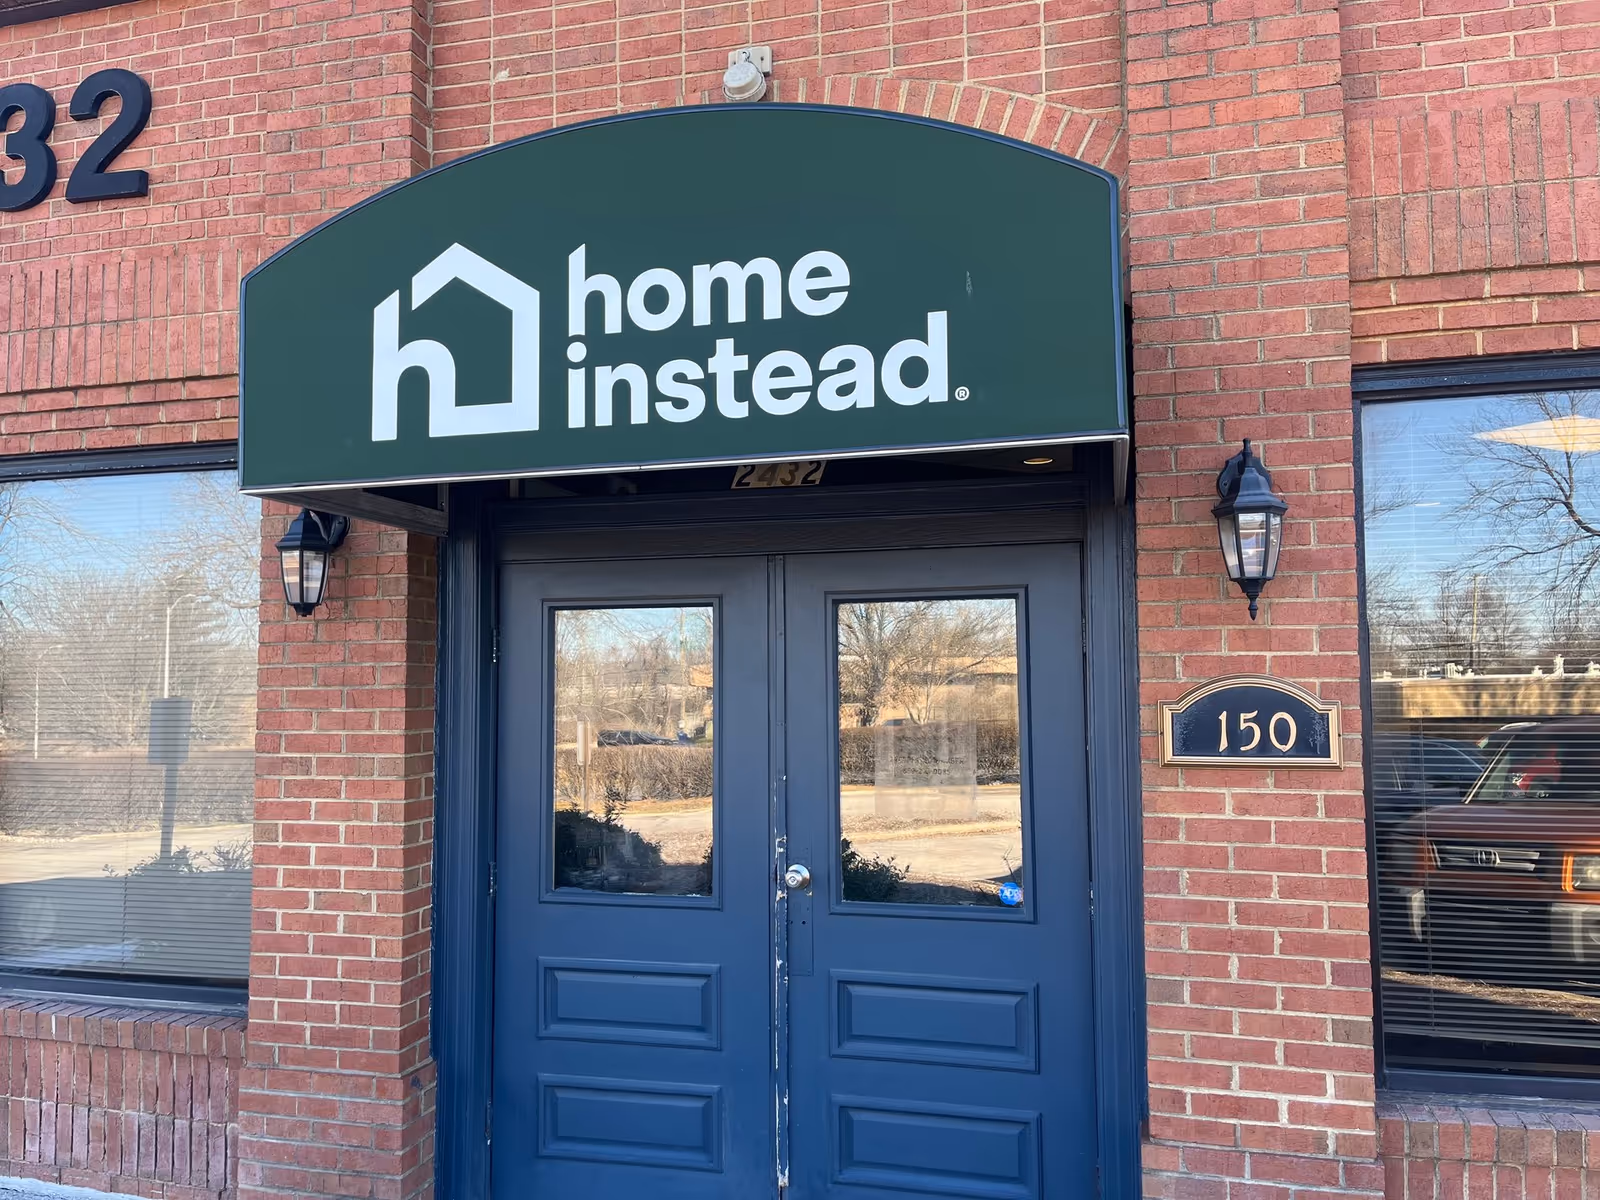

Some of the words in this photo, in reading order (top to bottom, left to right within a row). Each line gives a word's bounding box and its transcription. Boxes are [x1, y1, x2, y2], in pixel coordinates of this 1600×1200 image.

[0, 68, 152, 212] 32
[567, 243, 851, 337] home
[735, 461, 821, 487] 2432
[1218, 710, 1297, 753] 150
